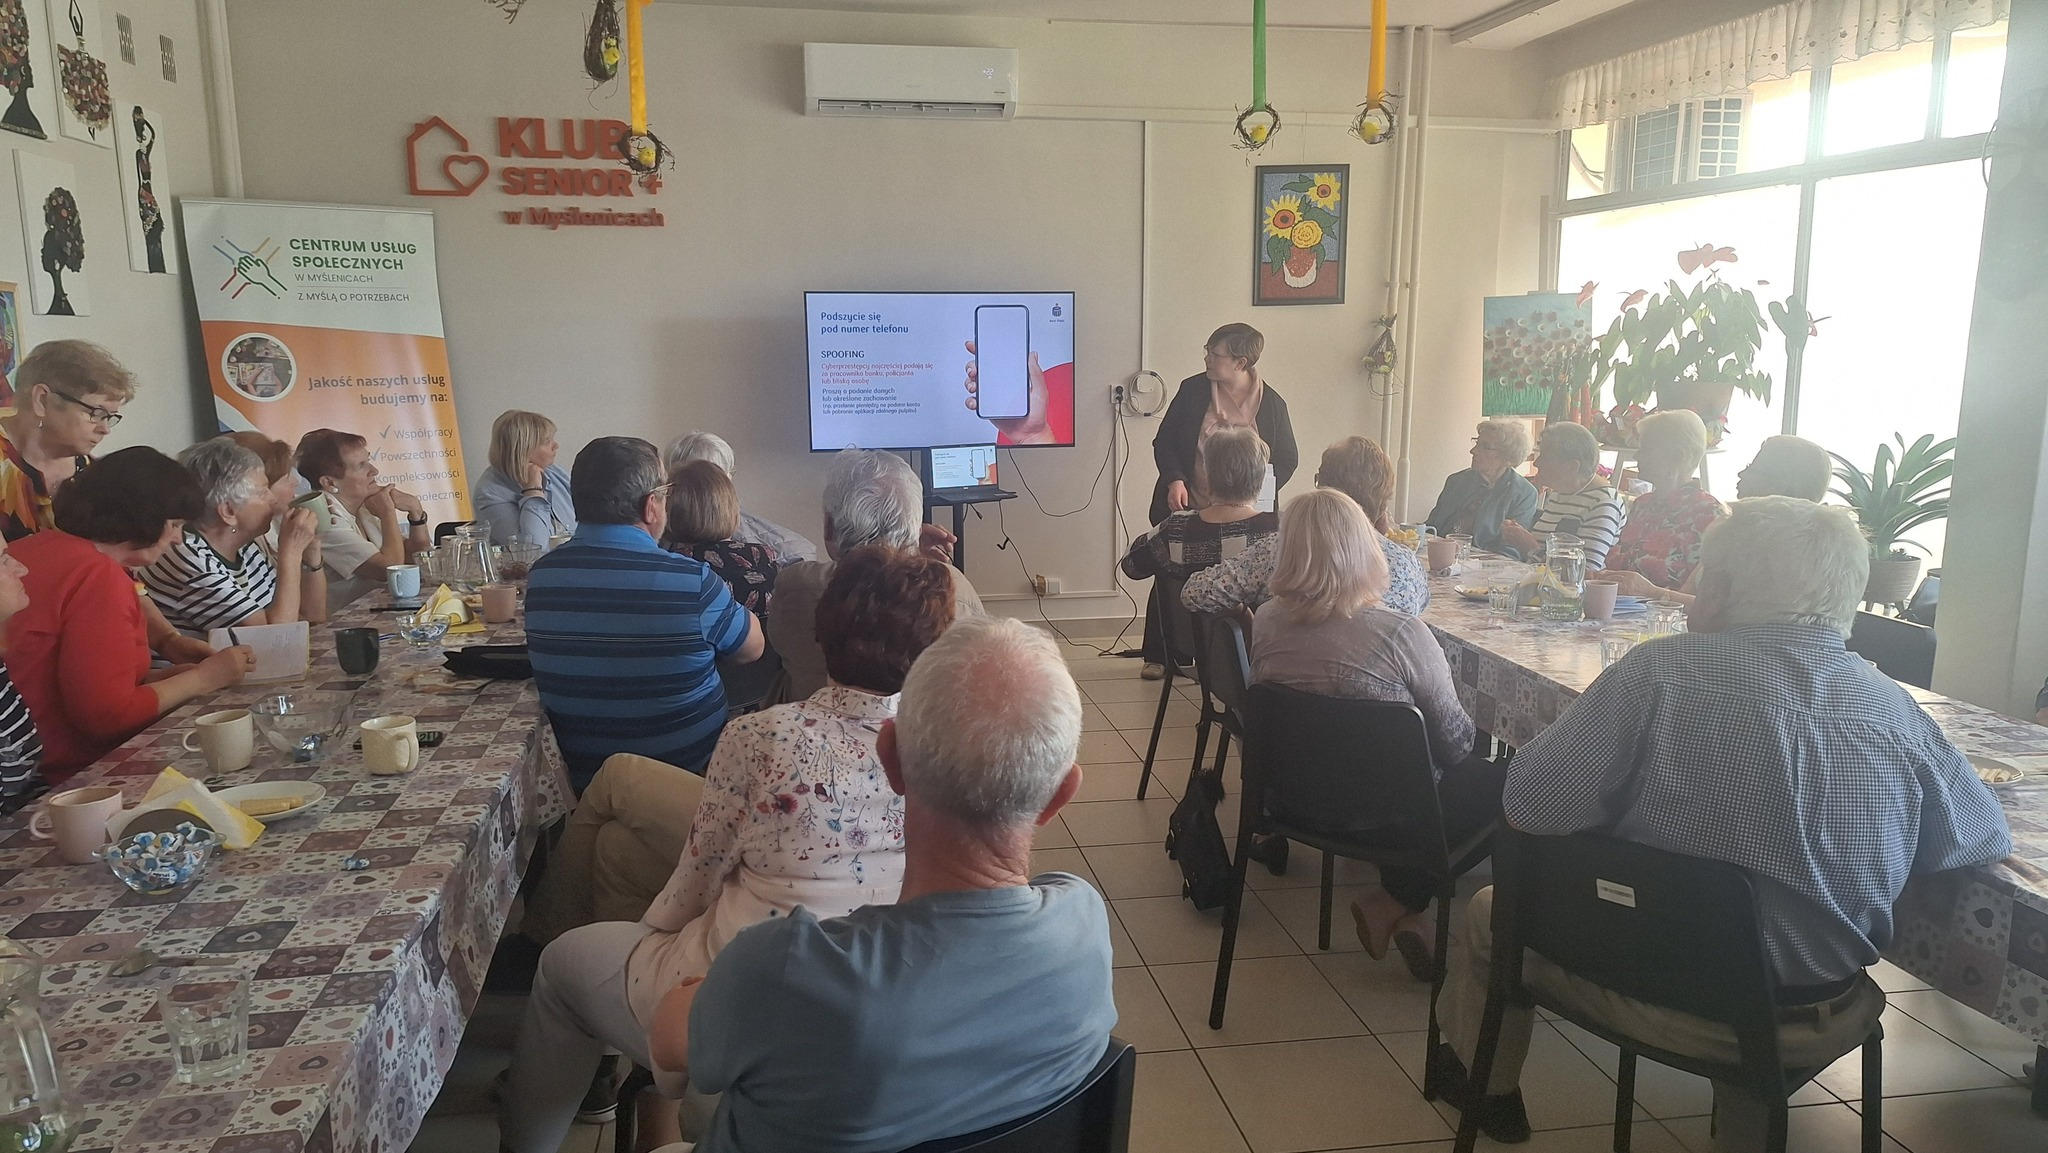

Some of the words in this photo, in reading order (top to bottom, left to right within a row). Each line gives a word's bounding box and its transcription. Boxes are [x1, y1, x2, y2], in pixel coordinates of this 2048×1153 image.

[497, 117, 632, 160] KLUB
[501, 167, 633, 197] SENIOR
[504, 209, 522, 225] w
[528, 206, 665, 230] Myślenicach
[289, 238, 367, 253] CENTRUM
[371, 241, 417, 255] USŁUG
[292, 255, 404, 271] SPOŁECZNYCH
[294, 273, 304, 282] W
[307, 271, 374, 284] MYŚLENICACH
[298, 292, 304, 301] Z
[306, 290, 338, 303] MYŚLĄ
[340, 293, 347, 301] O
[350, 293, 410, 302] POTRZEBACH
[821, 312, 866, 323] Podszycie
[868, 312, 881, 322] się
[821, 325, 838, 335] pod
[872, 324, 909, 333] telefonu
[821, 350, 865, 359] SPOOFING
[830, 370, 864, 378] pracownika
[308, 376, 353, 391] Jakość
[356, 374, 409, 389] naszych
[413, 374, 446, 388] usług
[822, 388, 841, 396] Proszą
[361, 393, 427, 407] budujemy
[430, 392, 448, 403] na:
[394, 428, 453, 441] Współpracy
[380, 447, 457, 462] Powszechności
[376, 468, 460, 485] Kompleksowości
[415, 489, 463, 502] połecznej
